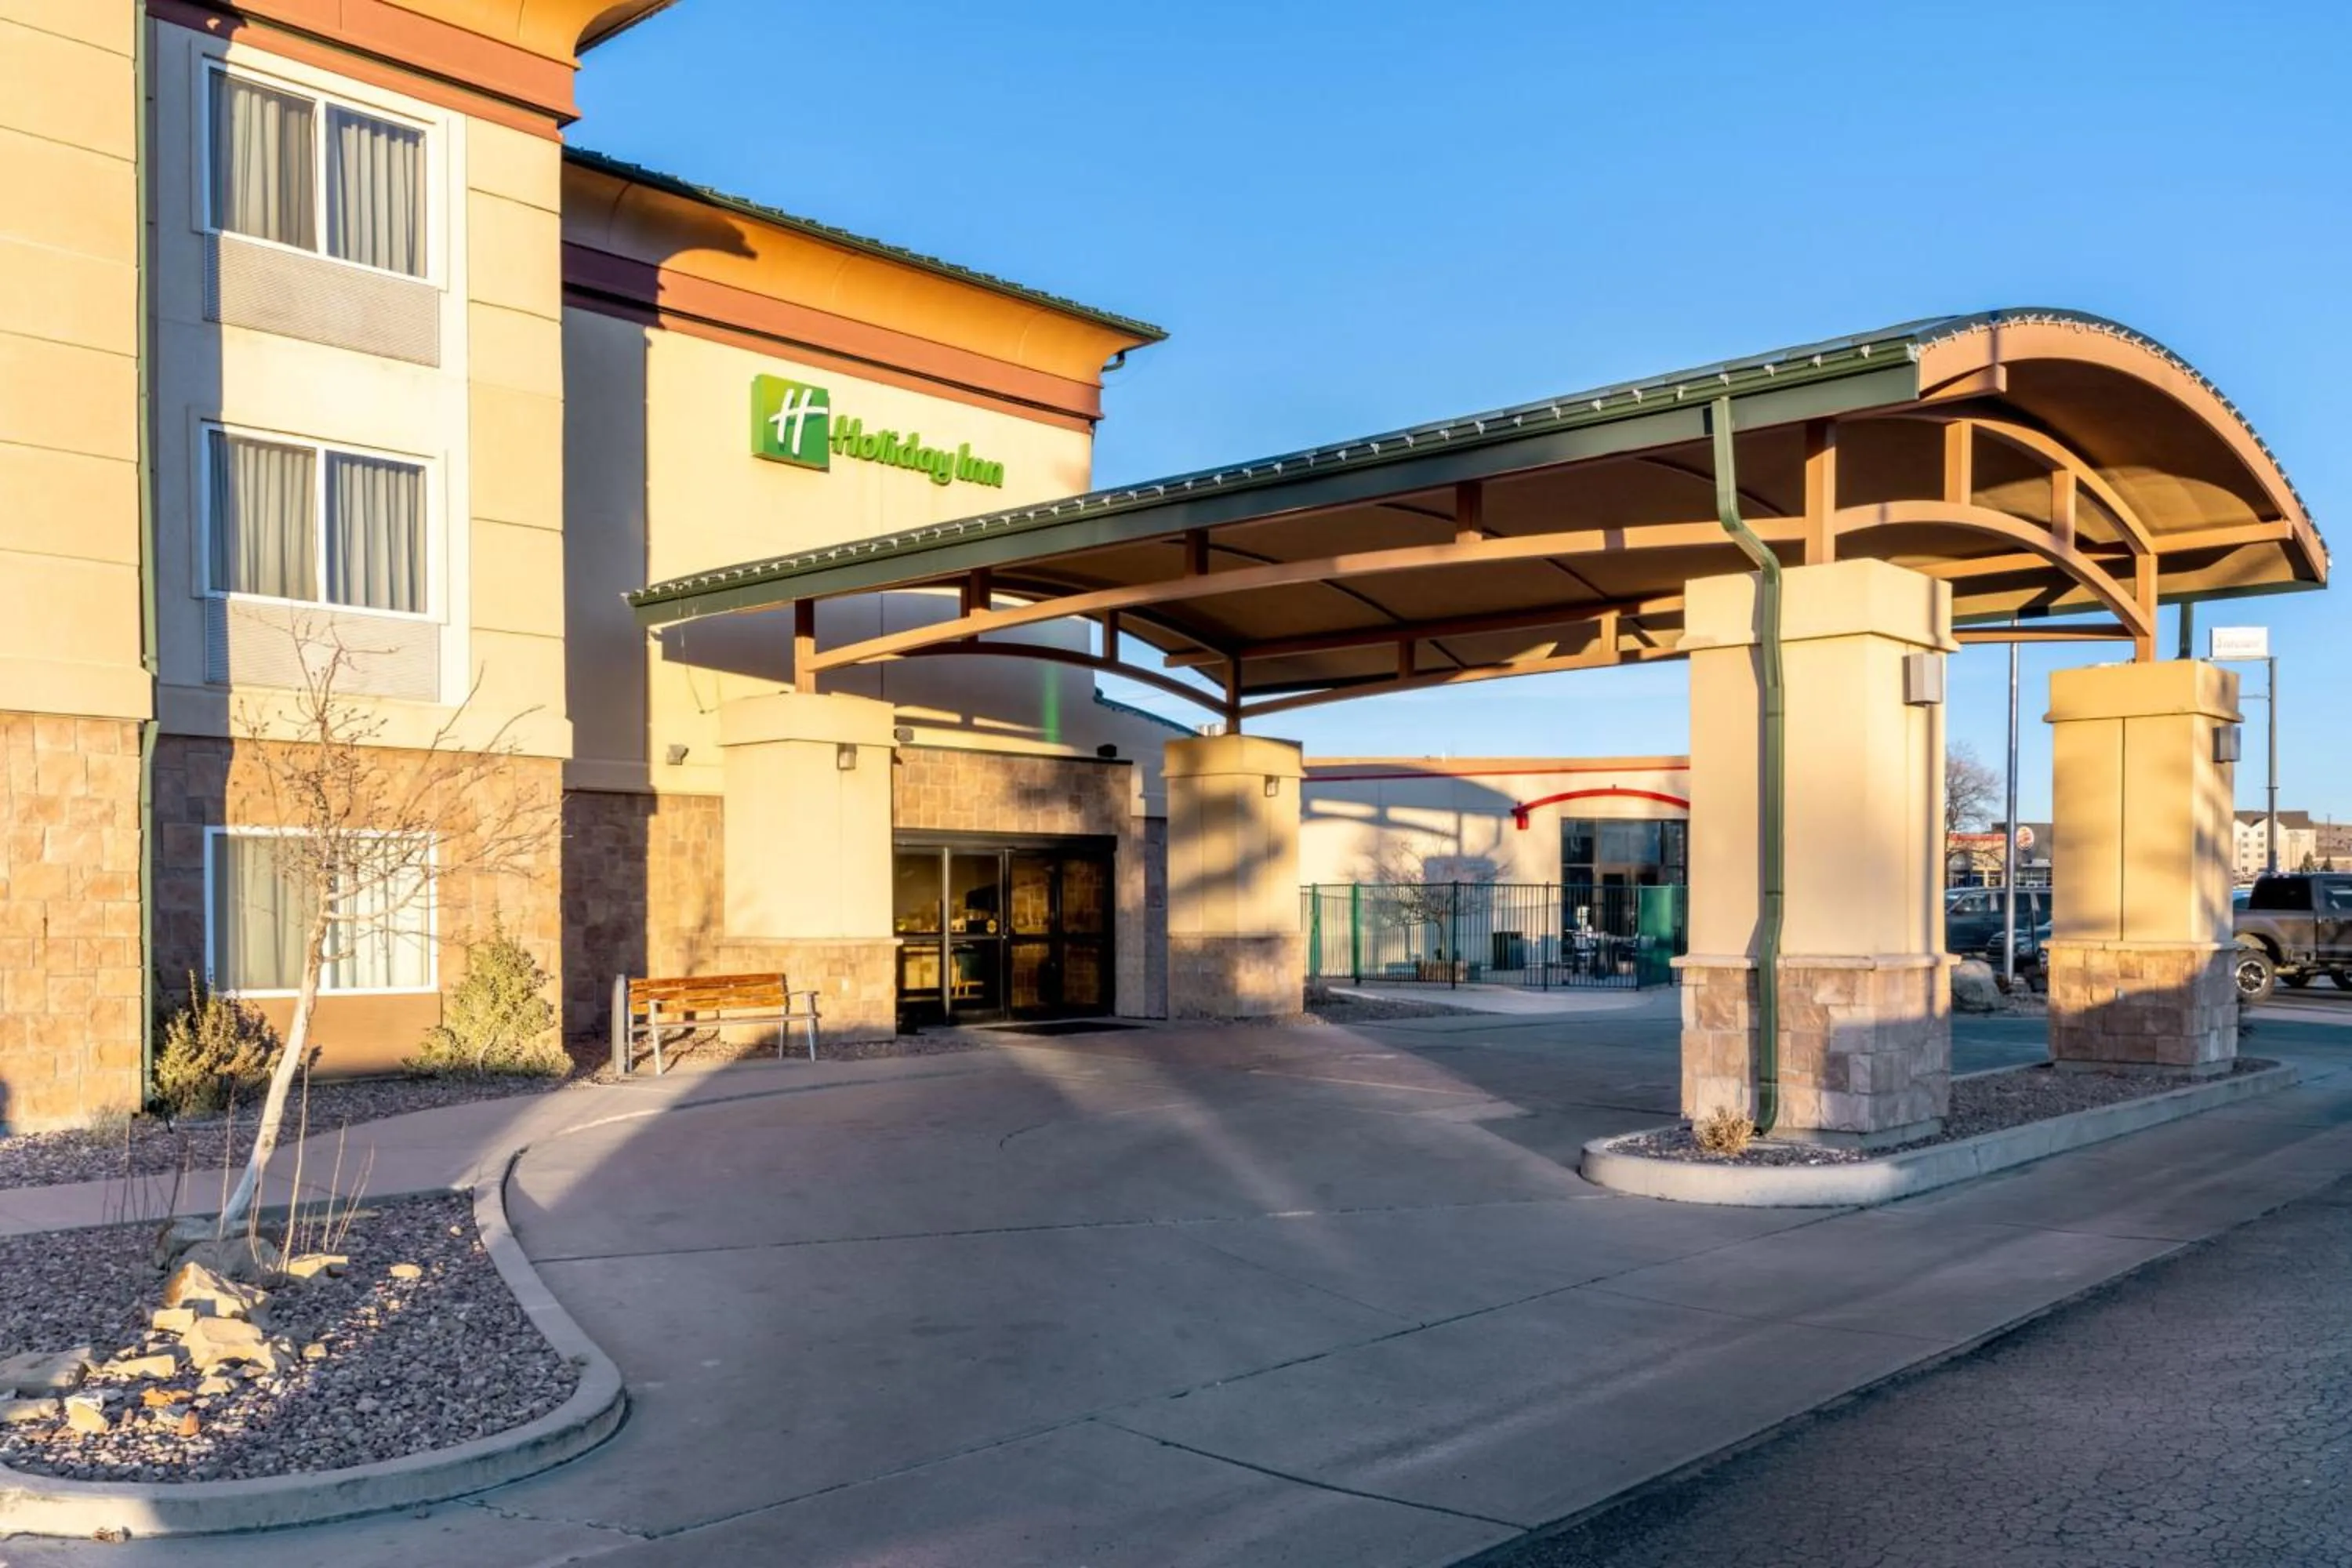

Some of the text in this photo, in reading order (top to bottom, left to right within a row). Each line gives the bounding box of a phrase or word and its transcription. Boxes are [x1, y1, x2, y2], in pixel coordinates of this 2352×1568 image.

[768, 389, 828, 455] H
[828, 415, 1004, 488] Holiday Inn
